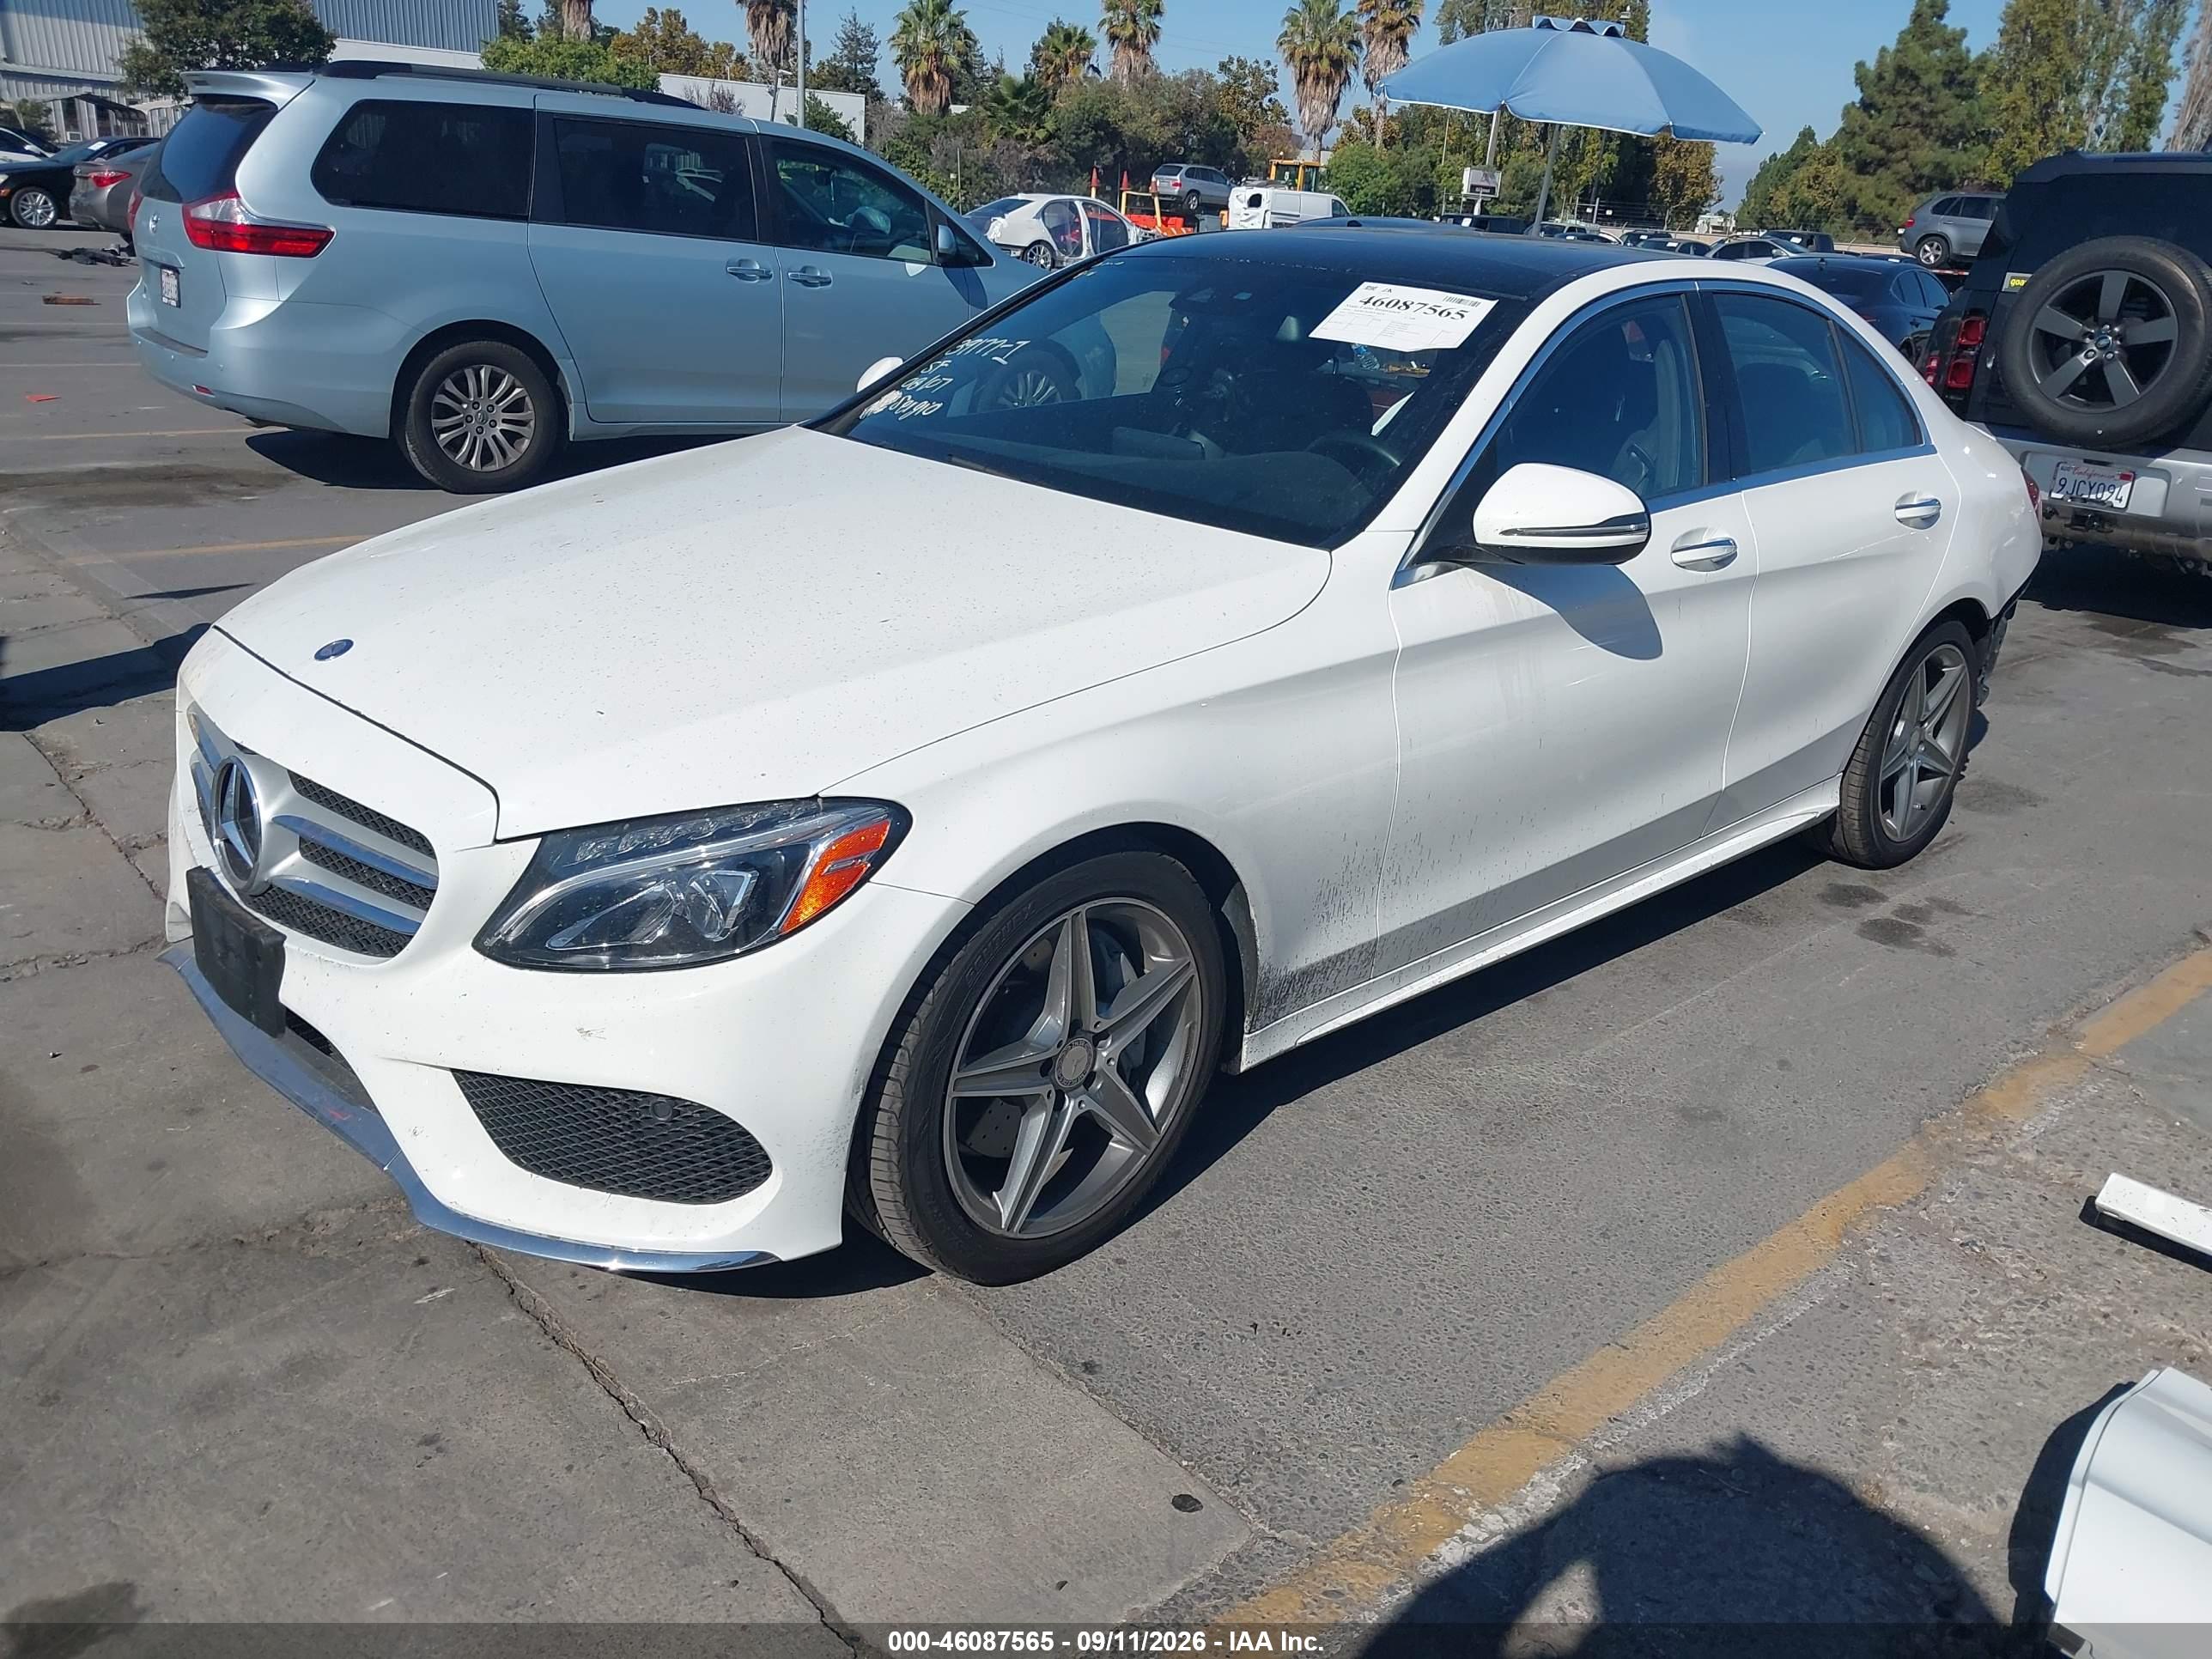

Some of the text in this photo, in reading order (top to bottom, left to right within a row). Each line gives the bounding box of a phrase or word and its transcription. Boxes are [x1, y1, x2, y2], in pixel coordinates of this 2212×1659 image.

[2010, 278, 2027, 288] goa
[1358, 295, 1470, 320] 46087565
[921, 359, 952, 374] SF
[2056, 477, 2124, 504] 9JCY094
